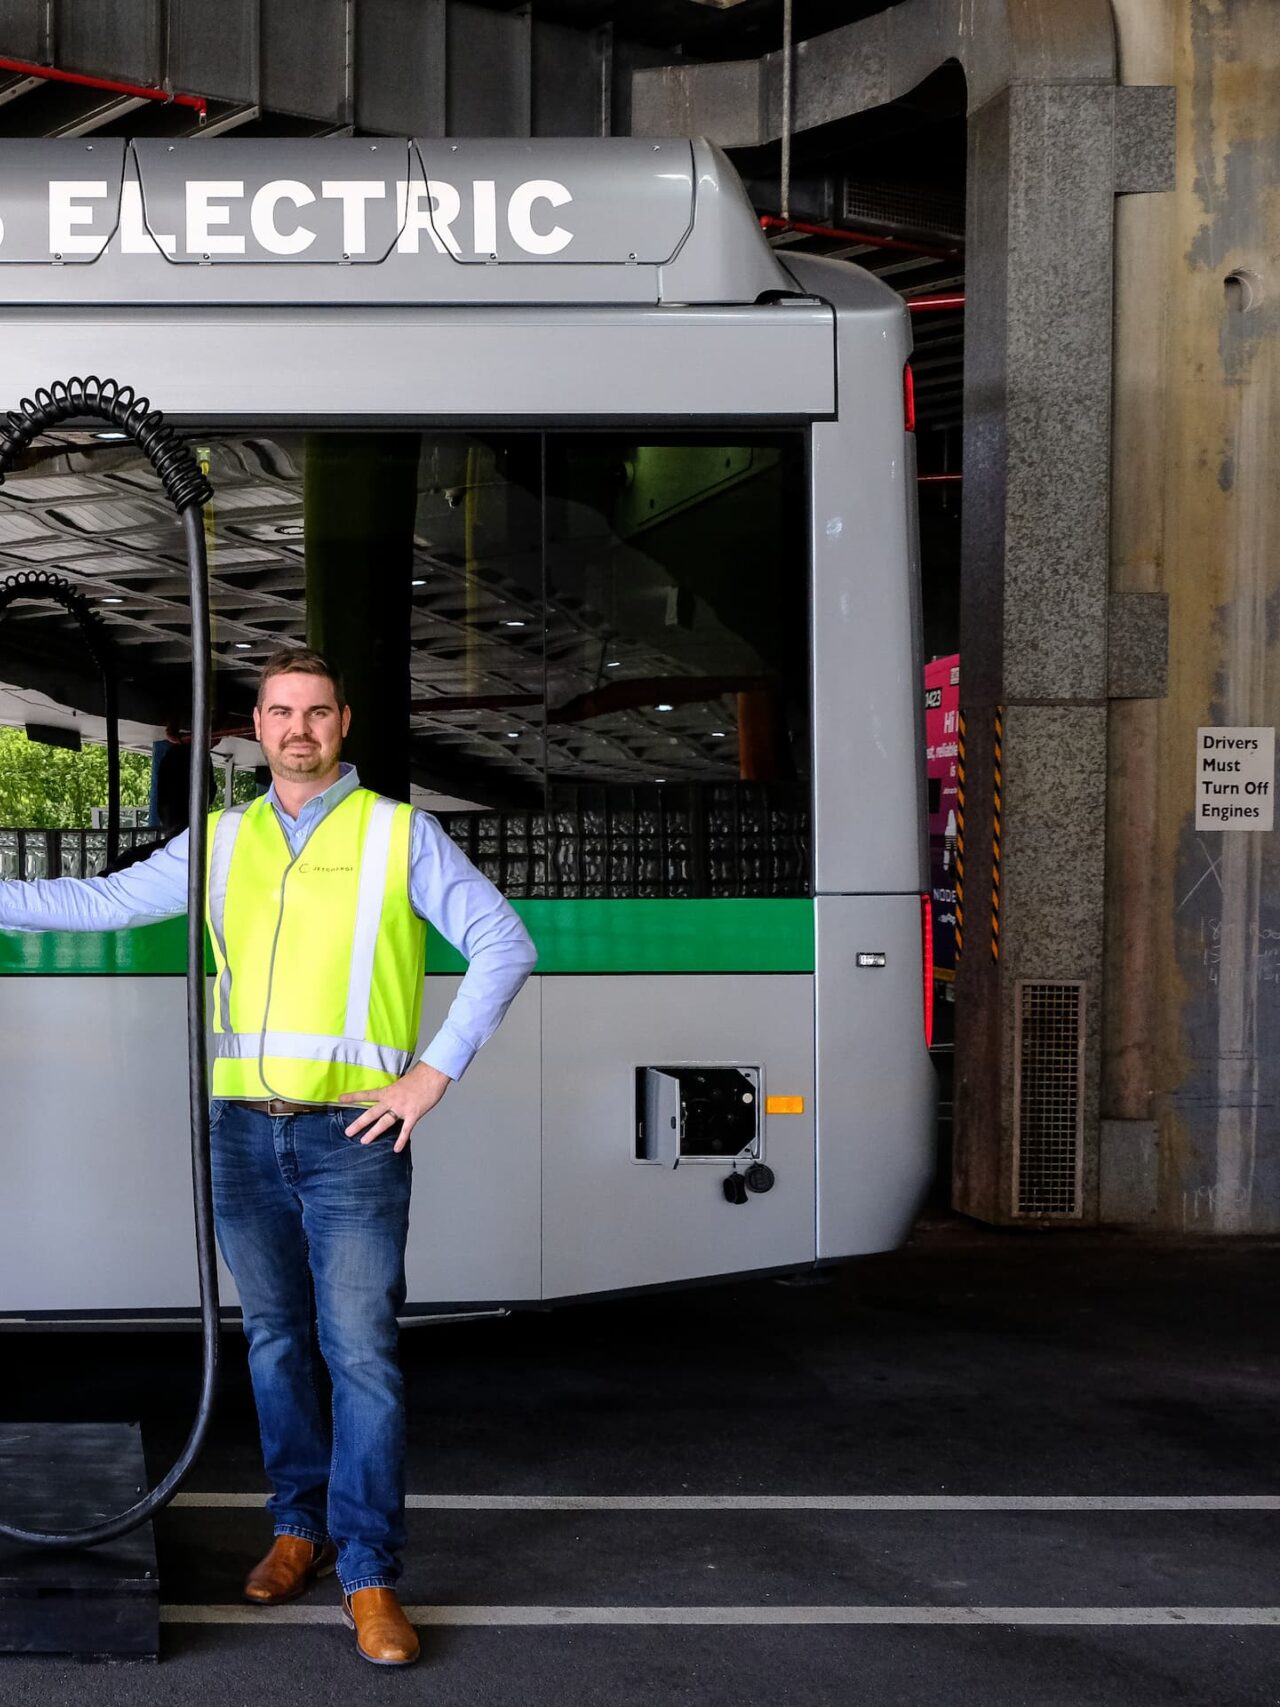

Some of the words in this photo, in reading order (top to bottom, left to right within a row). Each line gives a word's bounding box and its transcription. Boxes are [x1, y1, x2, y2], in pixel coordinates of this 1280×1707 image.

[48, 179, 574, 255] ELECTRIC
[1203, 735, 1258, 749] Drivers
[1203, 759, 1240, 772] Must
[1202, 781, 1239, 794] Turn
[1245, 781, 1269, 795] Off
[1202, 803, 1259, 821] Engines
